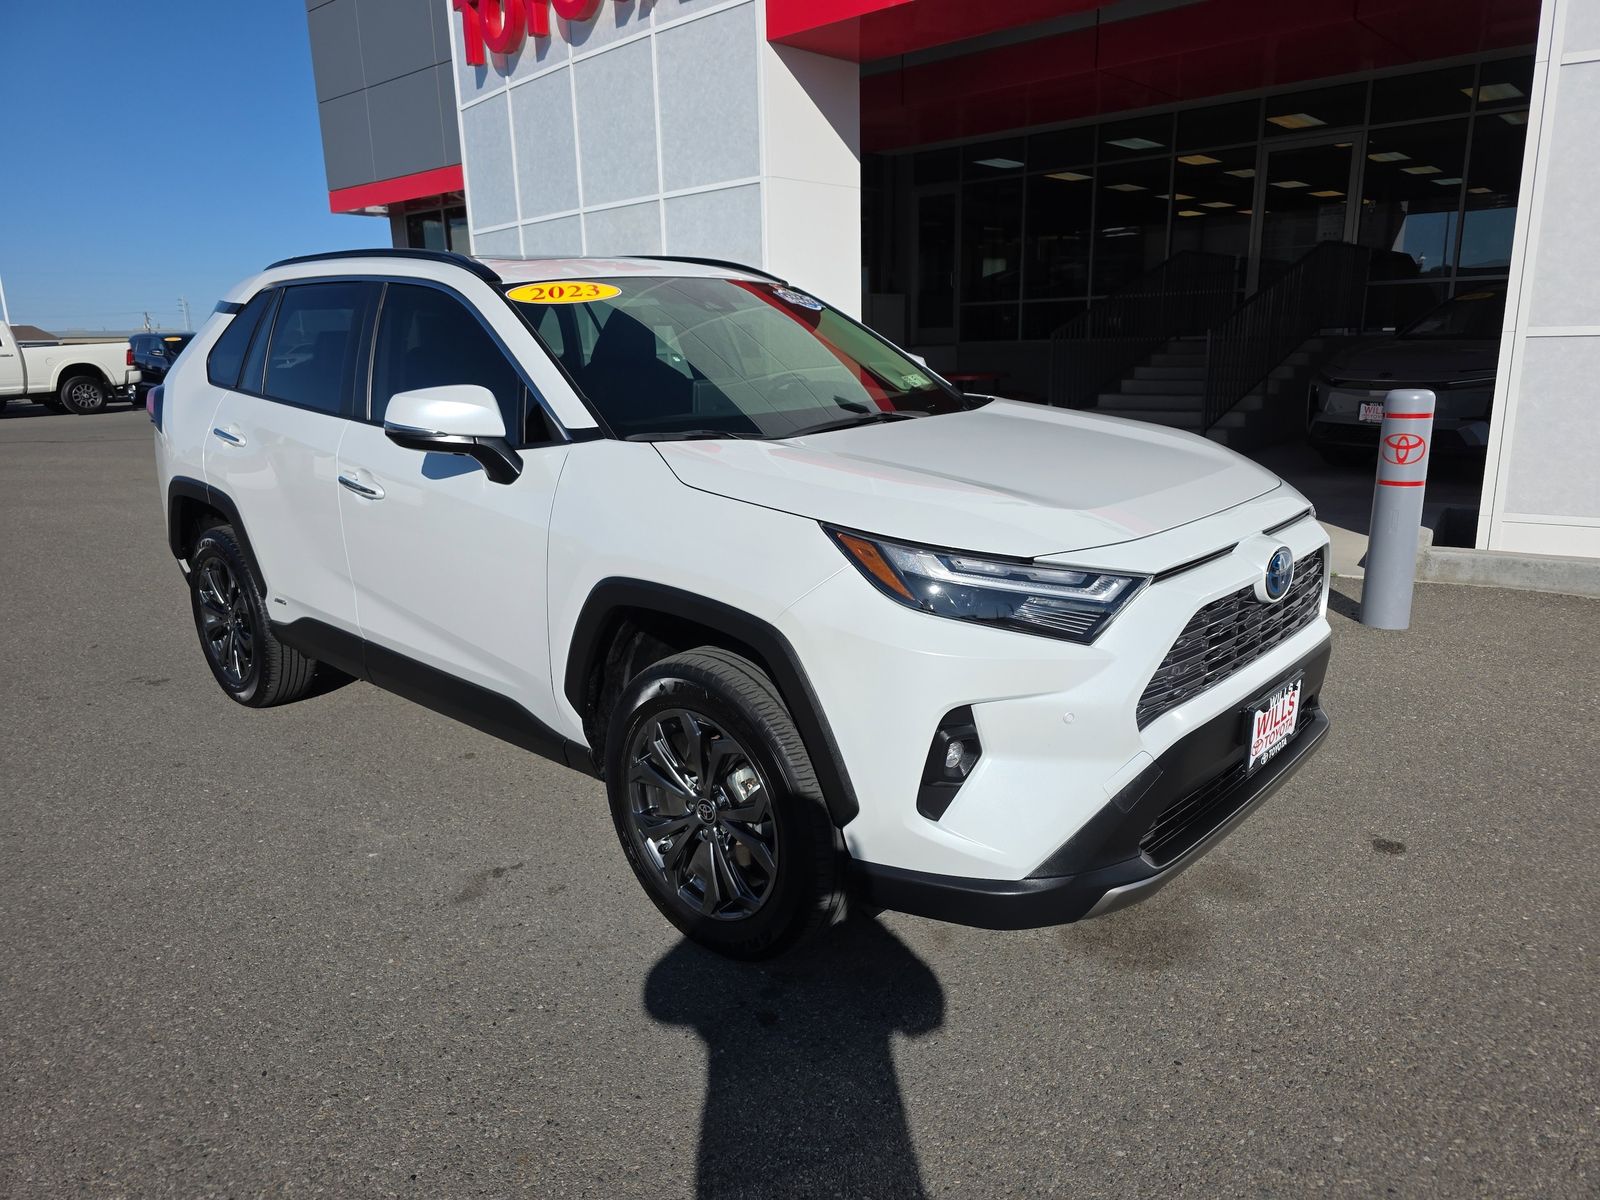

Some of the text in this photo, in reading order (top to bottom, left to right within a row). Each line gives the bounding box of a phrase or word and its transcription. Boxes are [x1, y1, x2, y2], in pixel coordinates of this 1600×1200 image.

[529, 284, 600, 301] 2023
[1257, 691, 1296, 739] WILLS
[1264, 716, 1293, 749] TOYOTA
[1268, 737, 1288, 758] TOYOTA
